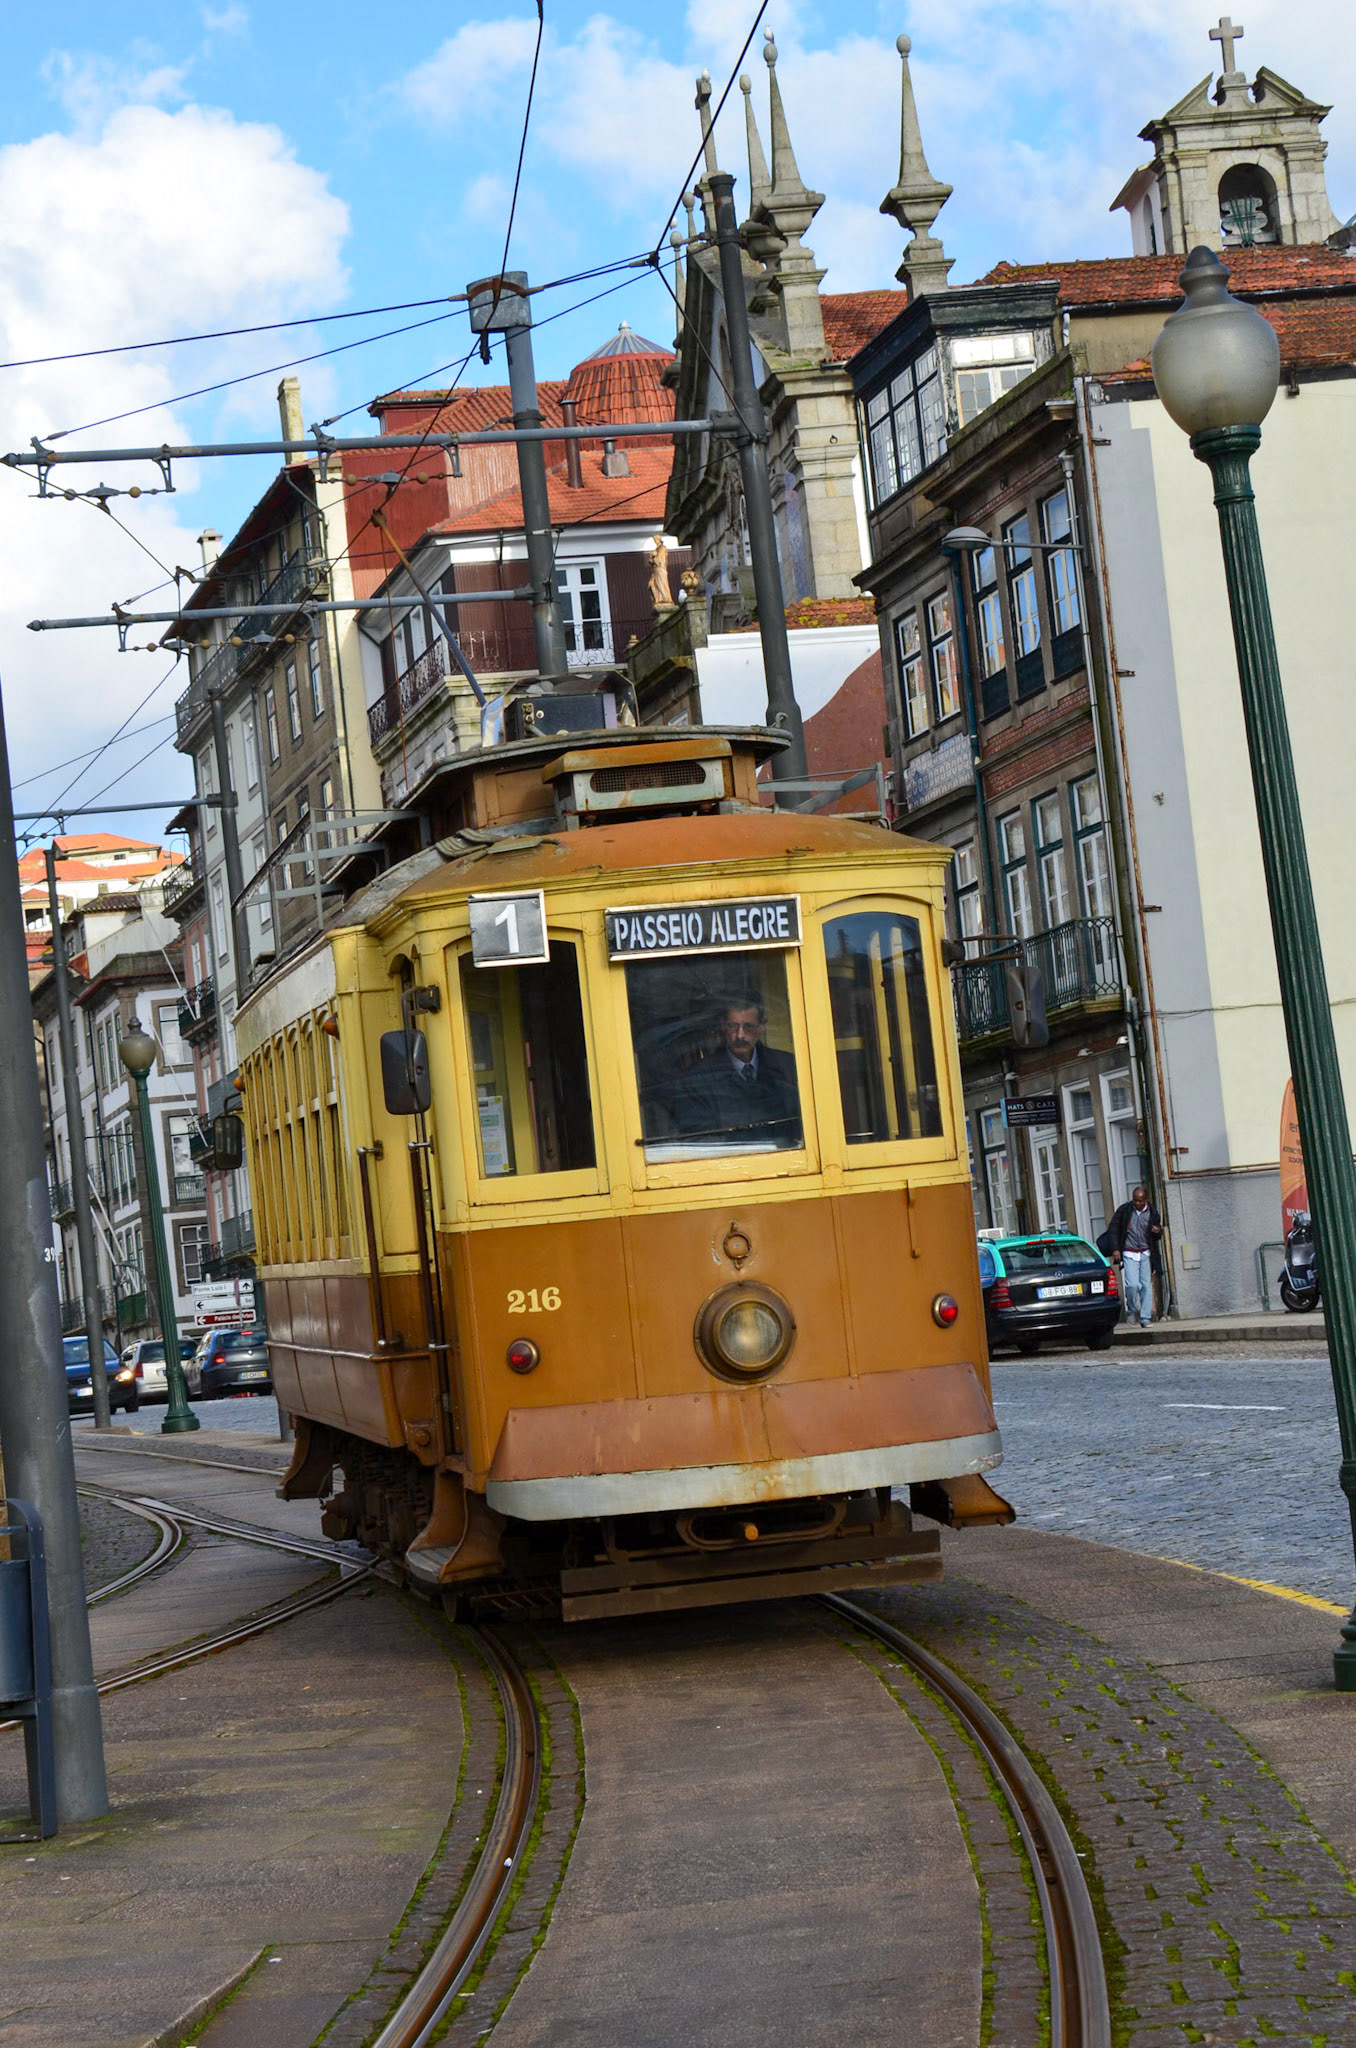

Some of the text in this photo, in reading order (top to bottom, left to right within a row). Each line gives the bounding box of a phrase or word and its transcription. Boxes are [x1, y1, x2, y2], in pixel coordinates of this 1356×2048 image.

[494, 903, 520, 954] 1
[614, 905, 790, 950] PASSEIO ALEGRE
[507, 1286, 562, 1314] 216
